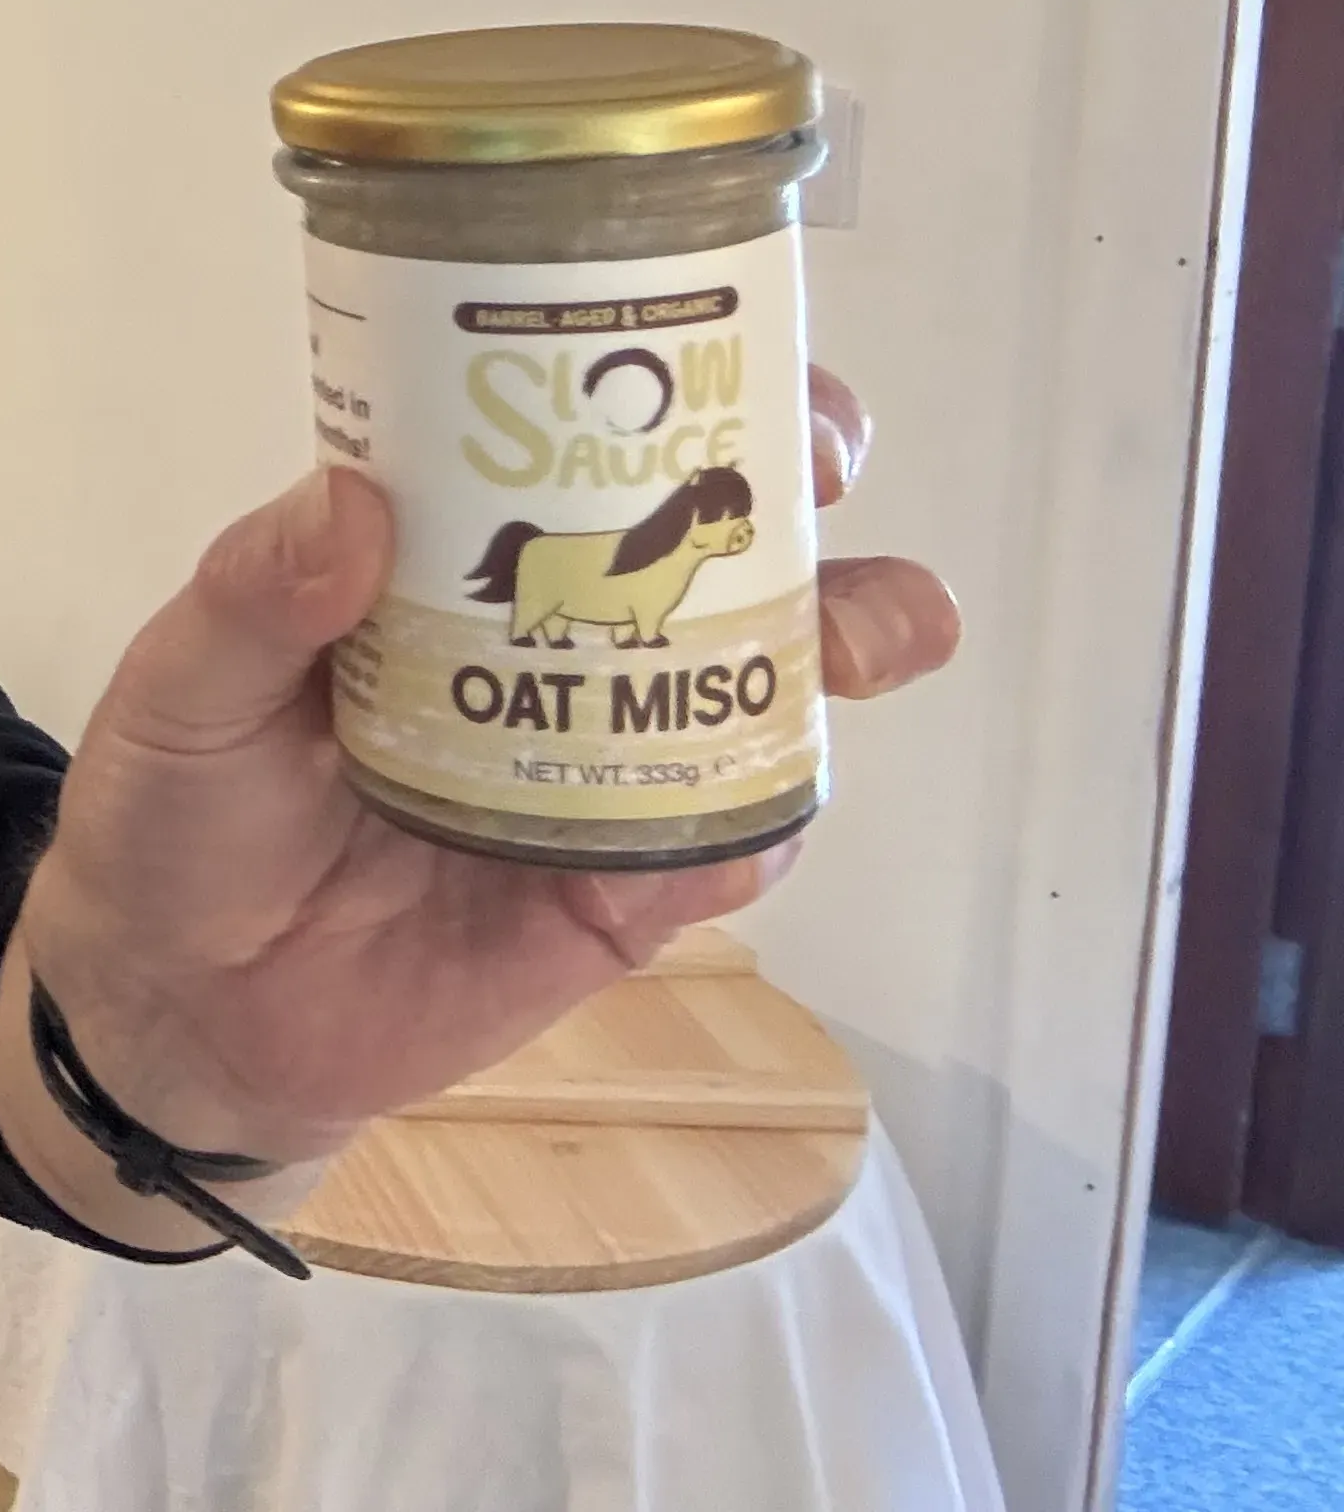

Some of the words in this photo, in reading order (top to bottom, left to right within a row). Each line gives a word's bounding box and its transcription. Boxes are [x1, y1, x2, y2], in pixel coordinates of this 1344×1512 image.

[462, 334, 743, 453] SLOW
[451, 664, 586, 733] OAT
[611, 654, 777, 734] MISO
[513, 758, 573, 785] NET
[636, 761, 701, 787] 333g
